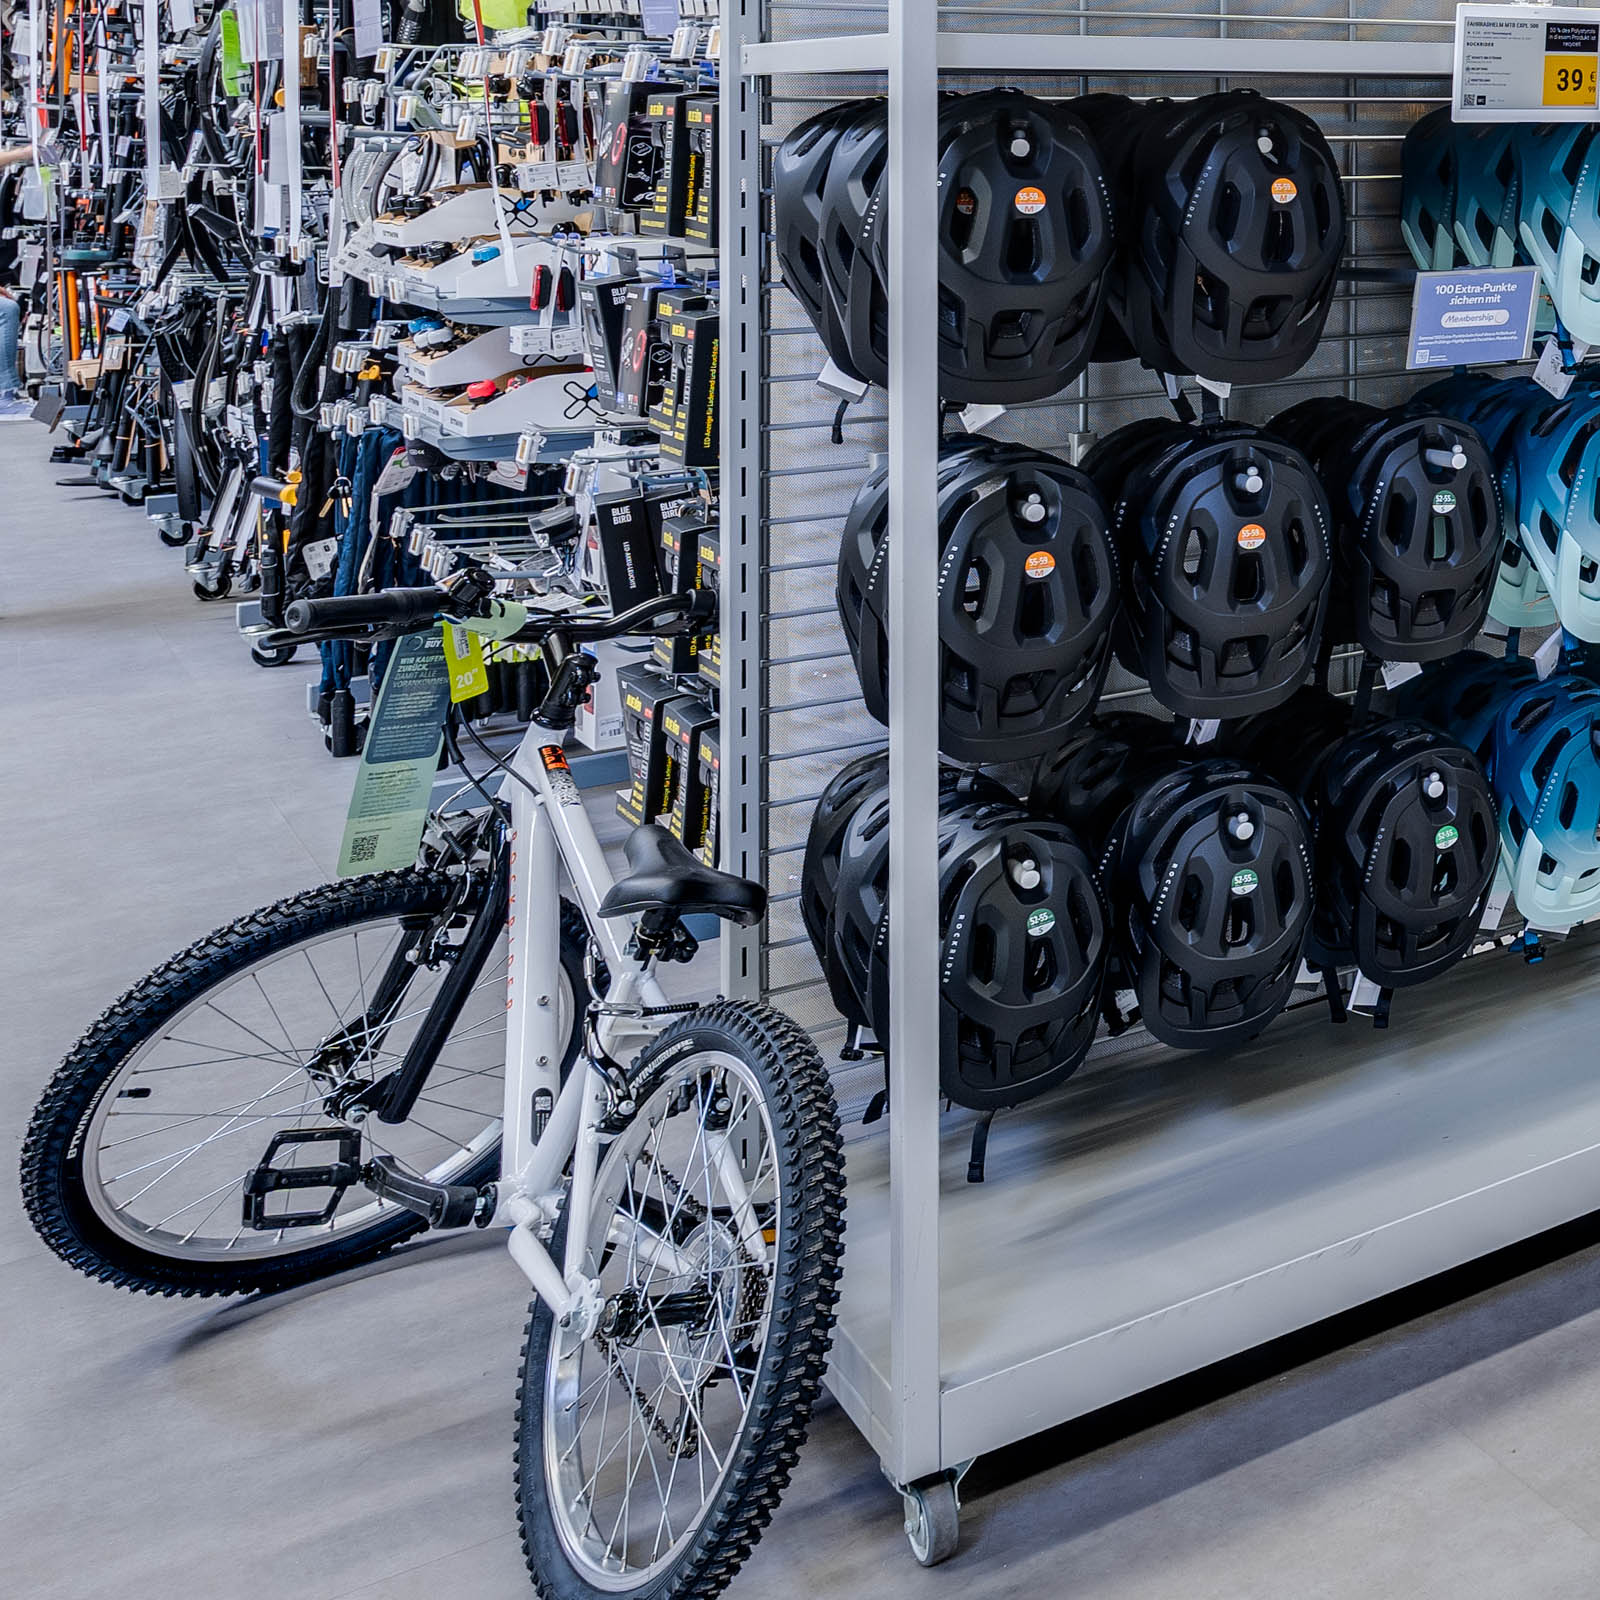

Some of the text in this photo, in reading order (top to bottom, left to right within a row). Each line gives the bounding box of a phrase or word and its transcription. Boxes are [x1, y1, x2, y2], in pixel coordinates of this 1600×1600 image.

[1556, 68, 1583, 92] 39
[1018, 191, 1039, 201] 55-59
[1184, 164, 1212, 227] ROCKRIDER
[611, 287, 627, 297] BLU
[1435, 282, 1518, 295] 100 Extra-Punkte
[1449, 293, 1501, 305] sichern mit
[1445, 312, 1495, 323] Membership
[1434, 493, 1453, 503] 52-55
[611, 505, 630, 517] BLUE
[613, 514, 632, 525] BIRD
[1241, 528, 1260, 539] 55-59
[1153, 513, 1179, 576] ROCKRIDER
[868, 535, 890, 591] OCKRIDER
[1028, 555, 1049, 566] 55-59
[400, 656, 415, 665] WIR
[1234, 872, 1252, 884] 52-55
[1151, 862, 1179, 925] ROCKRIDER
[1028, 910, 1049, 925] 52-55
[942, 913, 966, 984] ROCKRIDER
